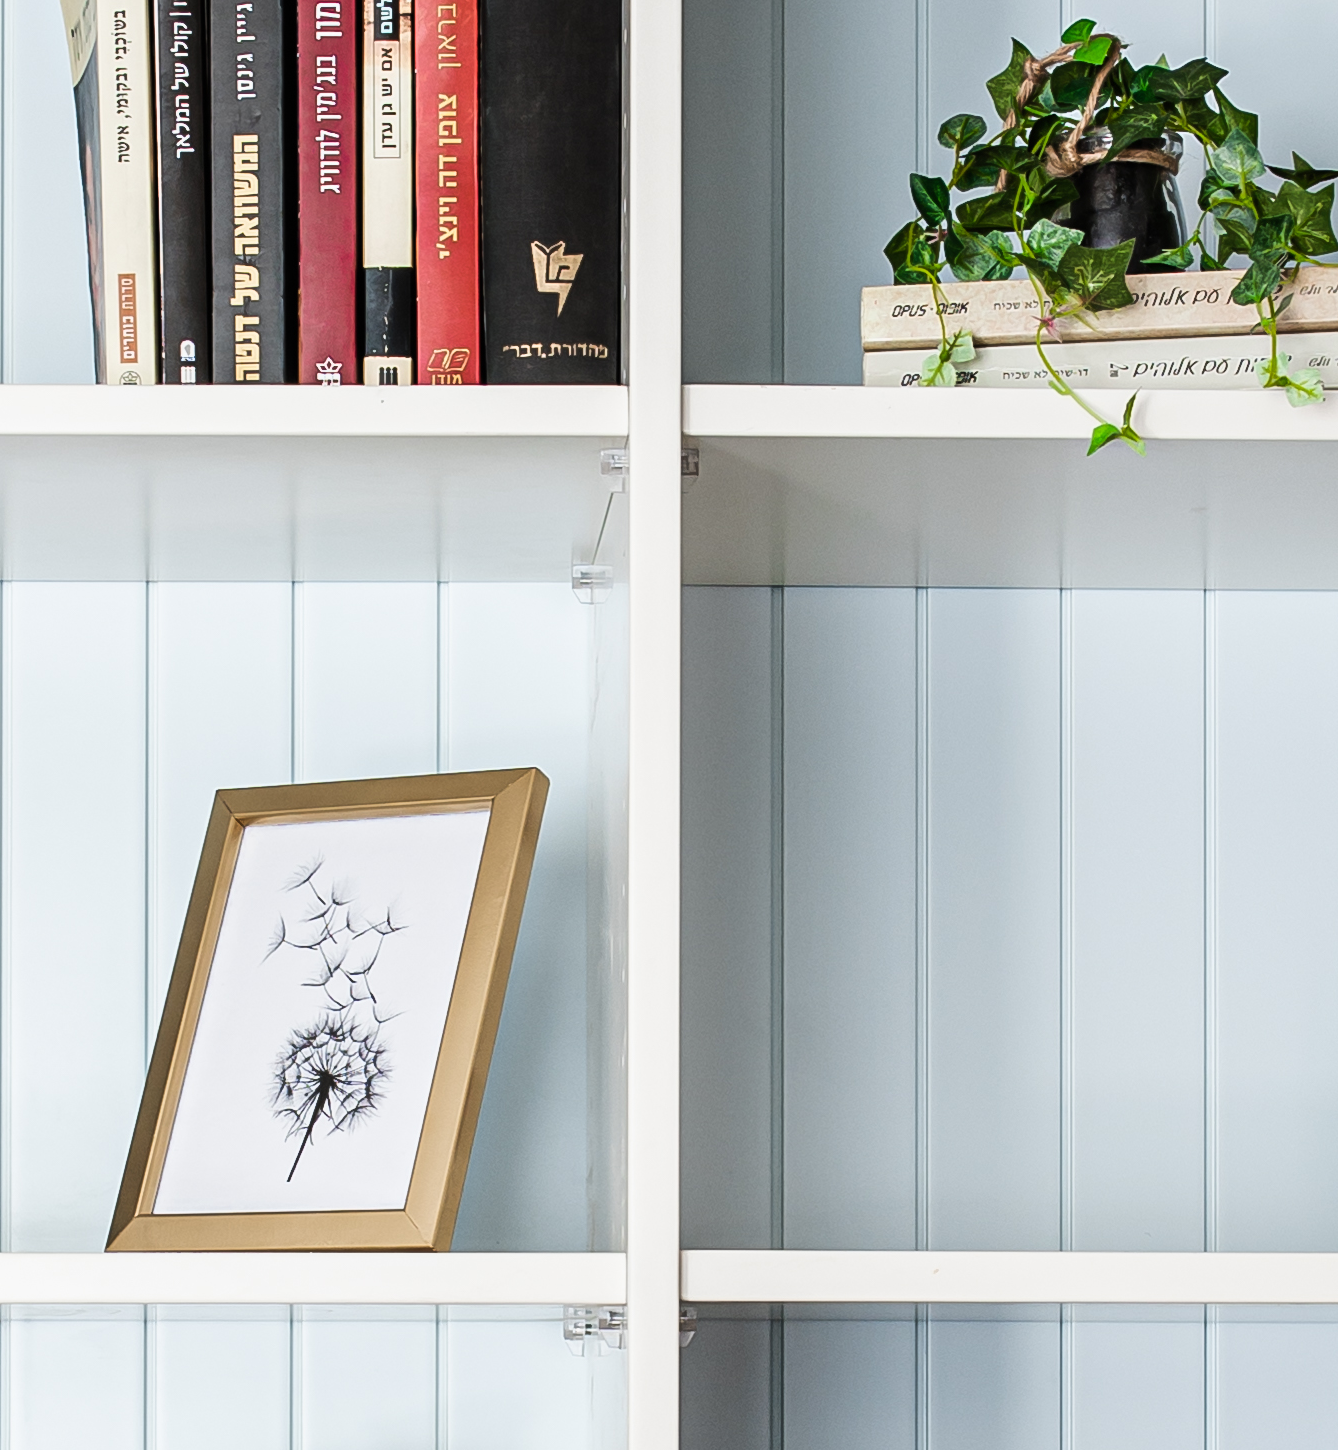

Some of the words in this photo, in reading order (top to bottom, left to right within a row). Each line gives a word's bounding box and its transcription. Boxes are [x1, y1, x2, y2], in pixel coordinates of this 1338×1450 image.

[315, 1, 343, 40] מון
[436, 2, 462, 69] בראון
[169, 22, 193, 57] קולו
[379, 47, 393, 67] אם
[171, 63, 190, 90] של
[379, 76, 393, 95] יש
[380, 100, 396, 116] גן
[437, 93, 462, 146] צופן
[171, 95, 196, 159] המלאך
[380, 121, 397, 150] עדן
[117, 125, 131, 163] אישה
[437, 154, 459, 188] דה
[232, 134, 261, 255] המשוואה
[120, 278, 134, 310] סדרת
[229, 264, 261, 307] של
[892, 304, 926, 318] OPUS
[993, 301, 1021, 311] שכיח
[1024, 300, 1041, 310] לא
[122, 314, 135, 359] כותרים
[234, 315, 261, 381] דנטה
[1133, 357, 1198, 378] אלוהים
[1201, 360, 1227, 376] עם
